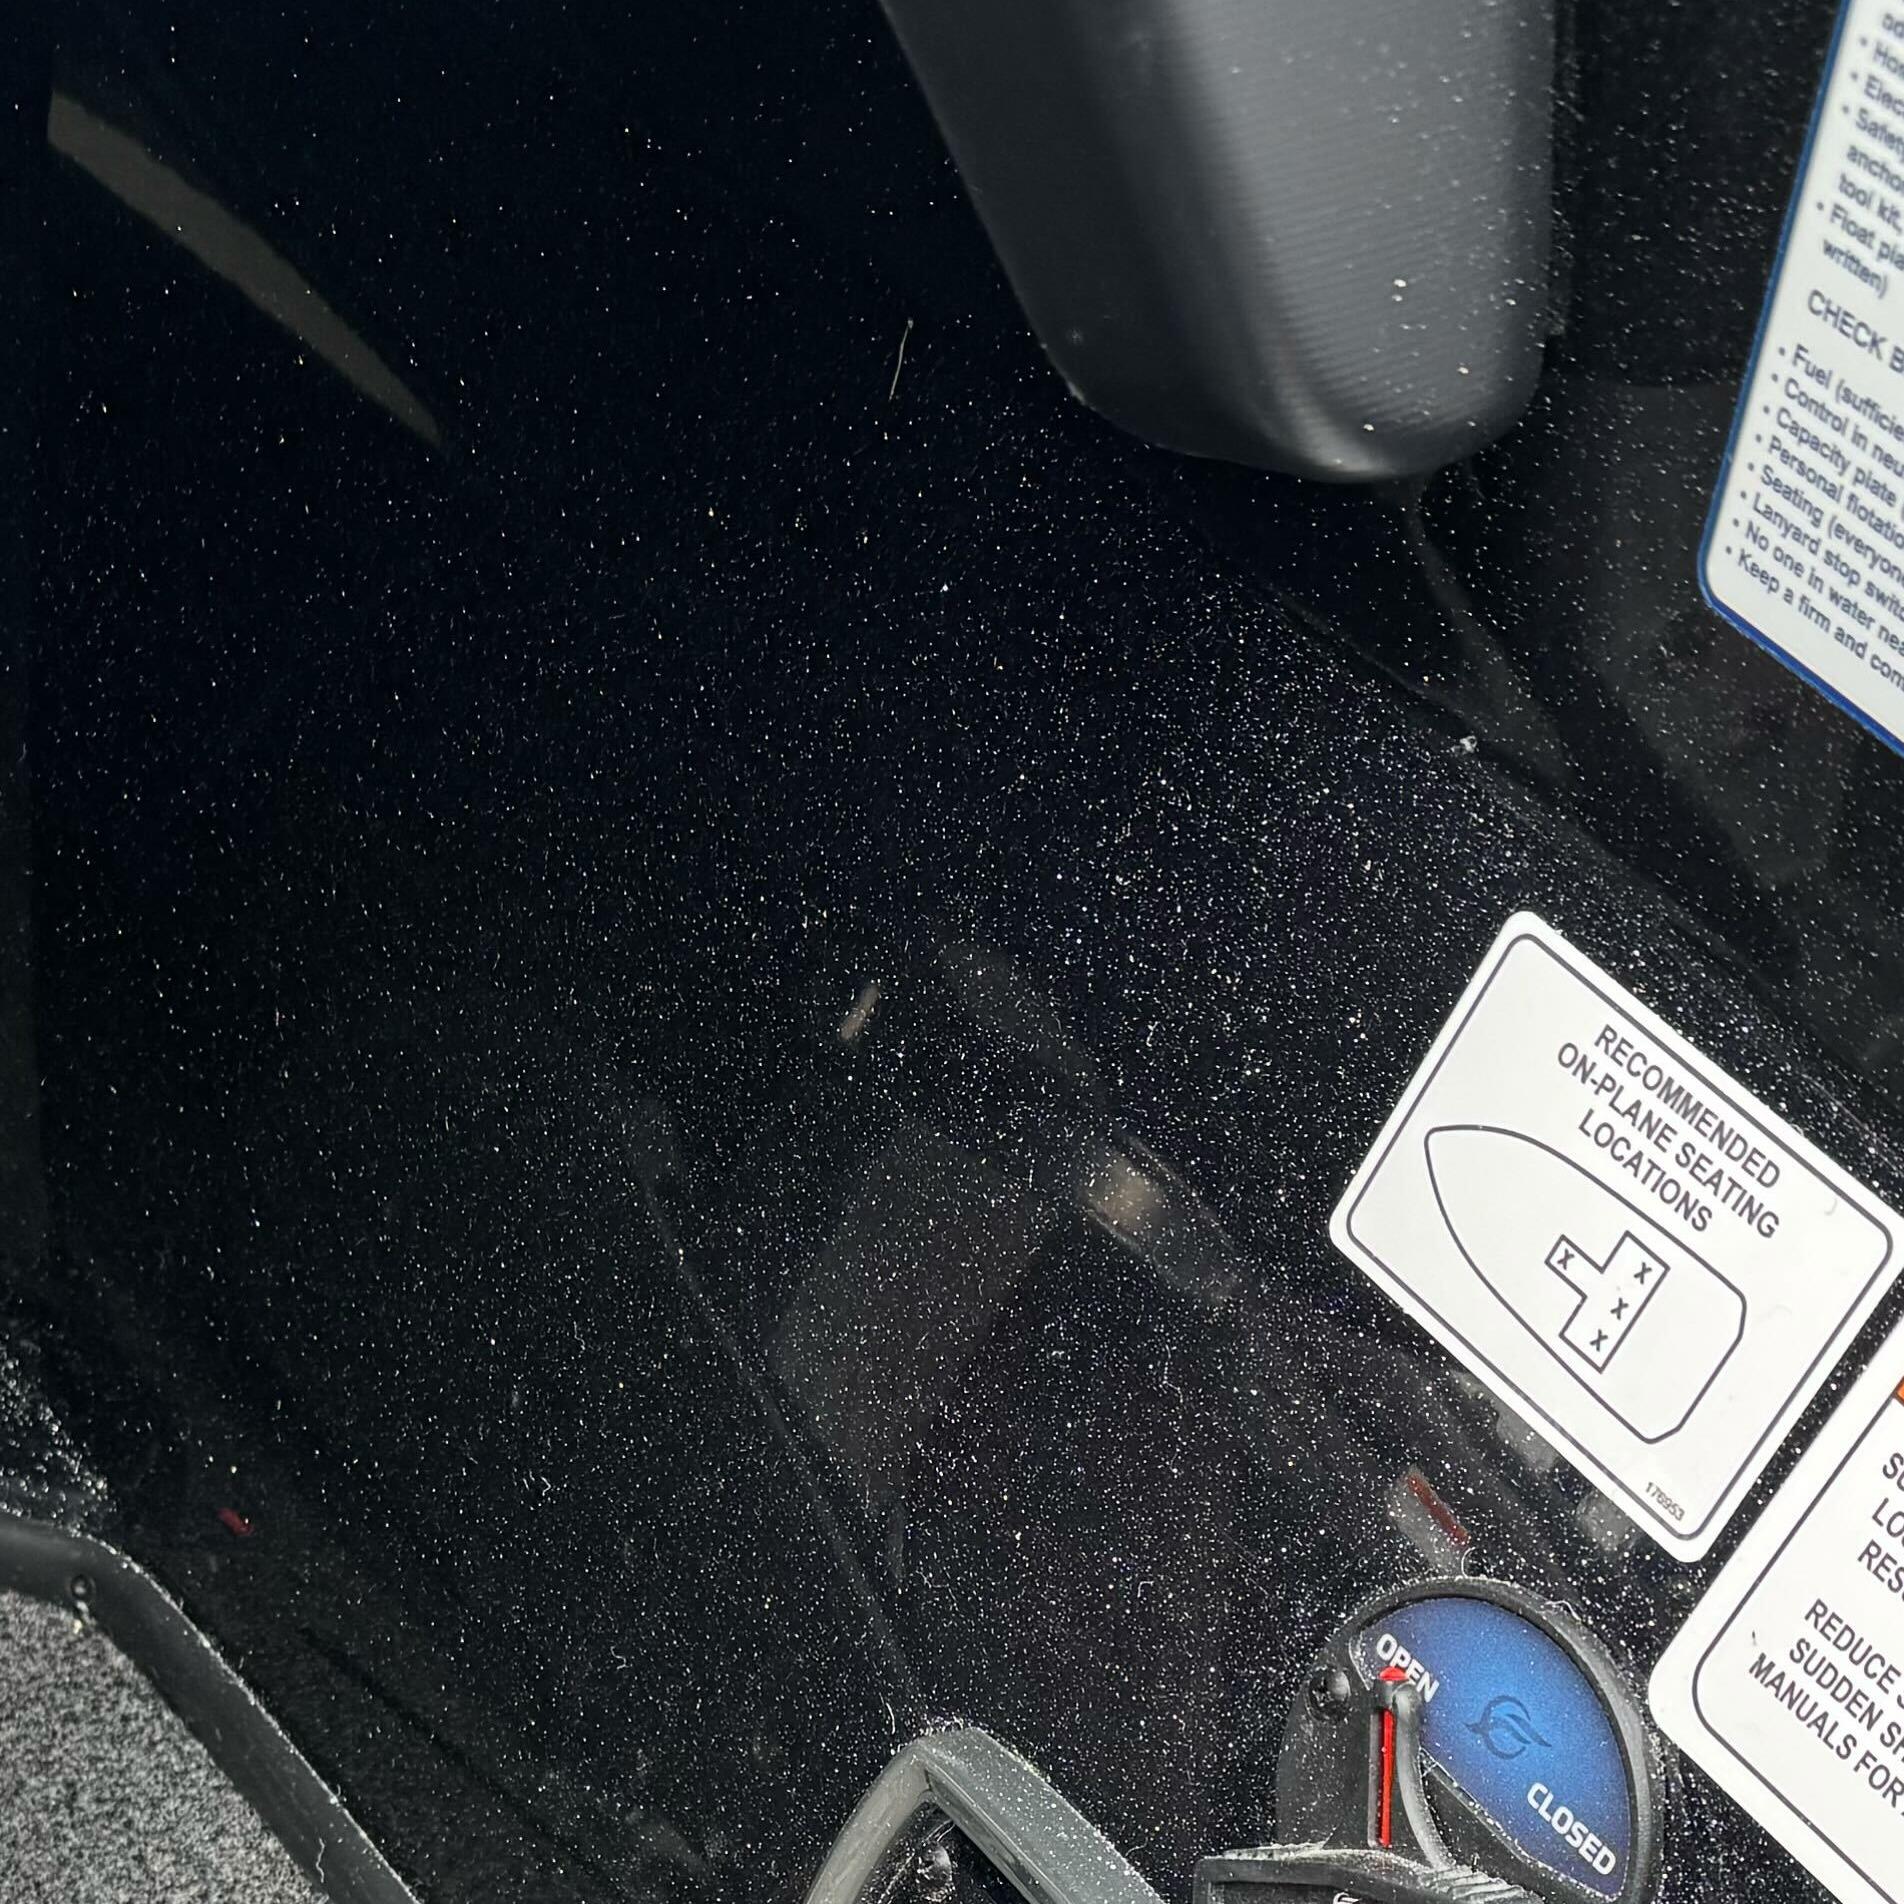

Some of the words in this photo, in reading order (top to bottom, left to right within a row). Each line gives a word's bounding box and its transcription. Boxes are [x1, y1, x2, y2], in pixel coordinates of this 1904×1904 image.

[1806, 288, 1888, 362] CHECK
[1744, 519, 1771, 553] No
[1771, 544, 1806, 580] one
[1806, 565, 1826, 595] in
[1827, 585, 1877, 632] water
[1751, 491, 1823, 557] Lanyard
[1822, 548, 1863, 589] stop
[1736, 547, 1781, 595] Keep
[1781, 586, 1795, 607] a
[1796, 593, 1833, 634] firm
[1832, 625, 1870, 661] and
[1556, 1041, 1679, 1154] ON-PLANE
[1673, 1140, 1781, 1240] SEATING
[1593, 1022, 1782, 1190] RECOMMENDED
[1576, 1107, 1714, 1233] LOCATIONS
[1376, 1633, 1440, 1703] OPEN
[1788, 1636, 1885, 1733] SUDDEN
[1803, 1597, 1903, 1696] REDUCE
[1747, 1651, 1859, 1761] MANUALS
[1527, 1782, 1617, 1875] CLOSED
